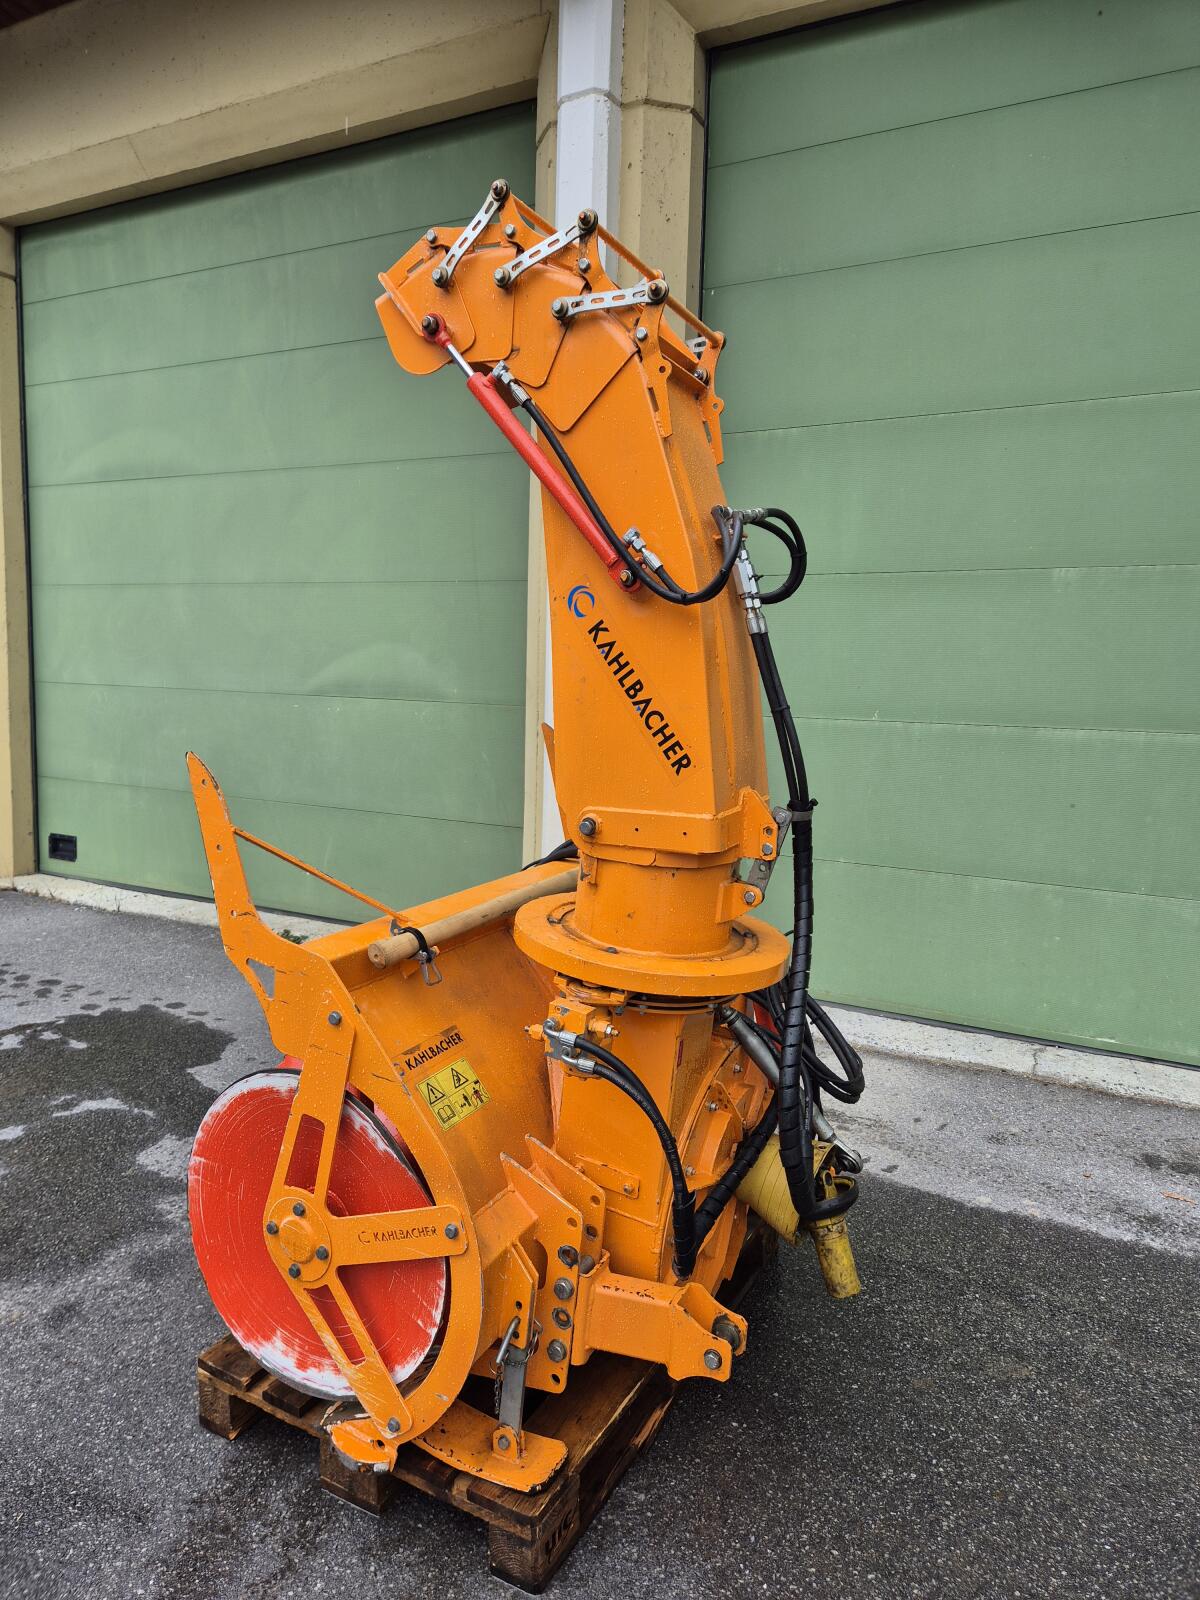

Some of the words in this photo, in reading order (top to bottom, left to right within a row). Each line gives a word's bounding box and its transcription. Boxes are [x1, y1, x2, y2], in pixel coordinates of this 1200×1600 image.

[587, 619, 692, 776] KAHLBACHER
[405, 1032, 464, 1071] KAHLBACHER
[373, 1226, 438, 1242] KAHLBACHER
